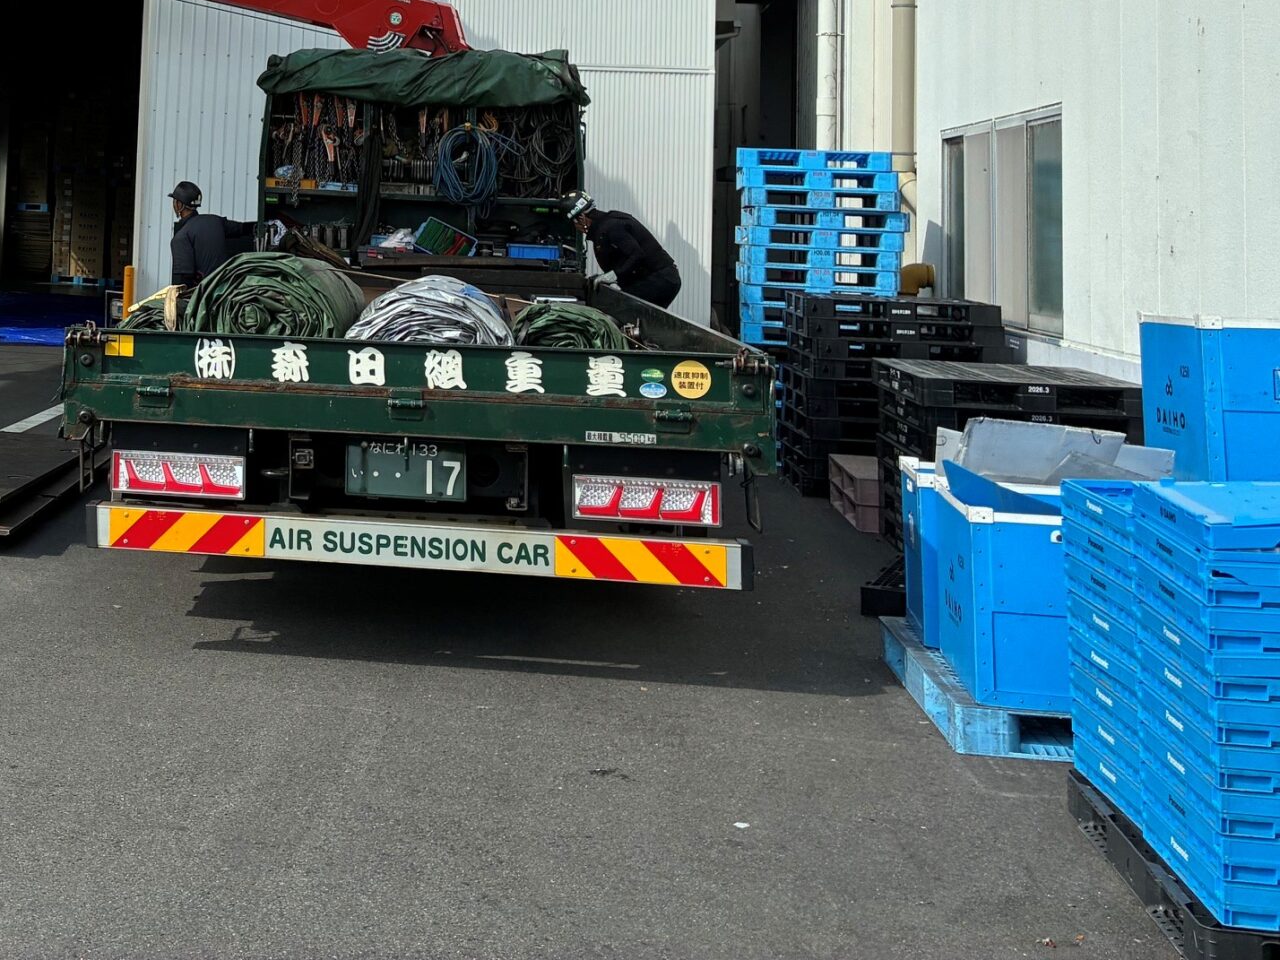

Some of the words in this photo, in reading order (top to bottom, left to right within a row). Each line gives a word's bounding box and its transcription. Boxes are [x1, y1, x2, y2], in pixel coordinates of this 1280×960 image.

[678, 381, 704, 390] 装置付
[1156, 407, 1186, 429] DAIHO
[412, 443, 438, 457] 133
[269, 527, 313, 552] AIR
[322, 530, 487, 563] SUSPENSION
[496, 542, 550, 567] CAR
